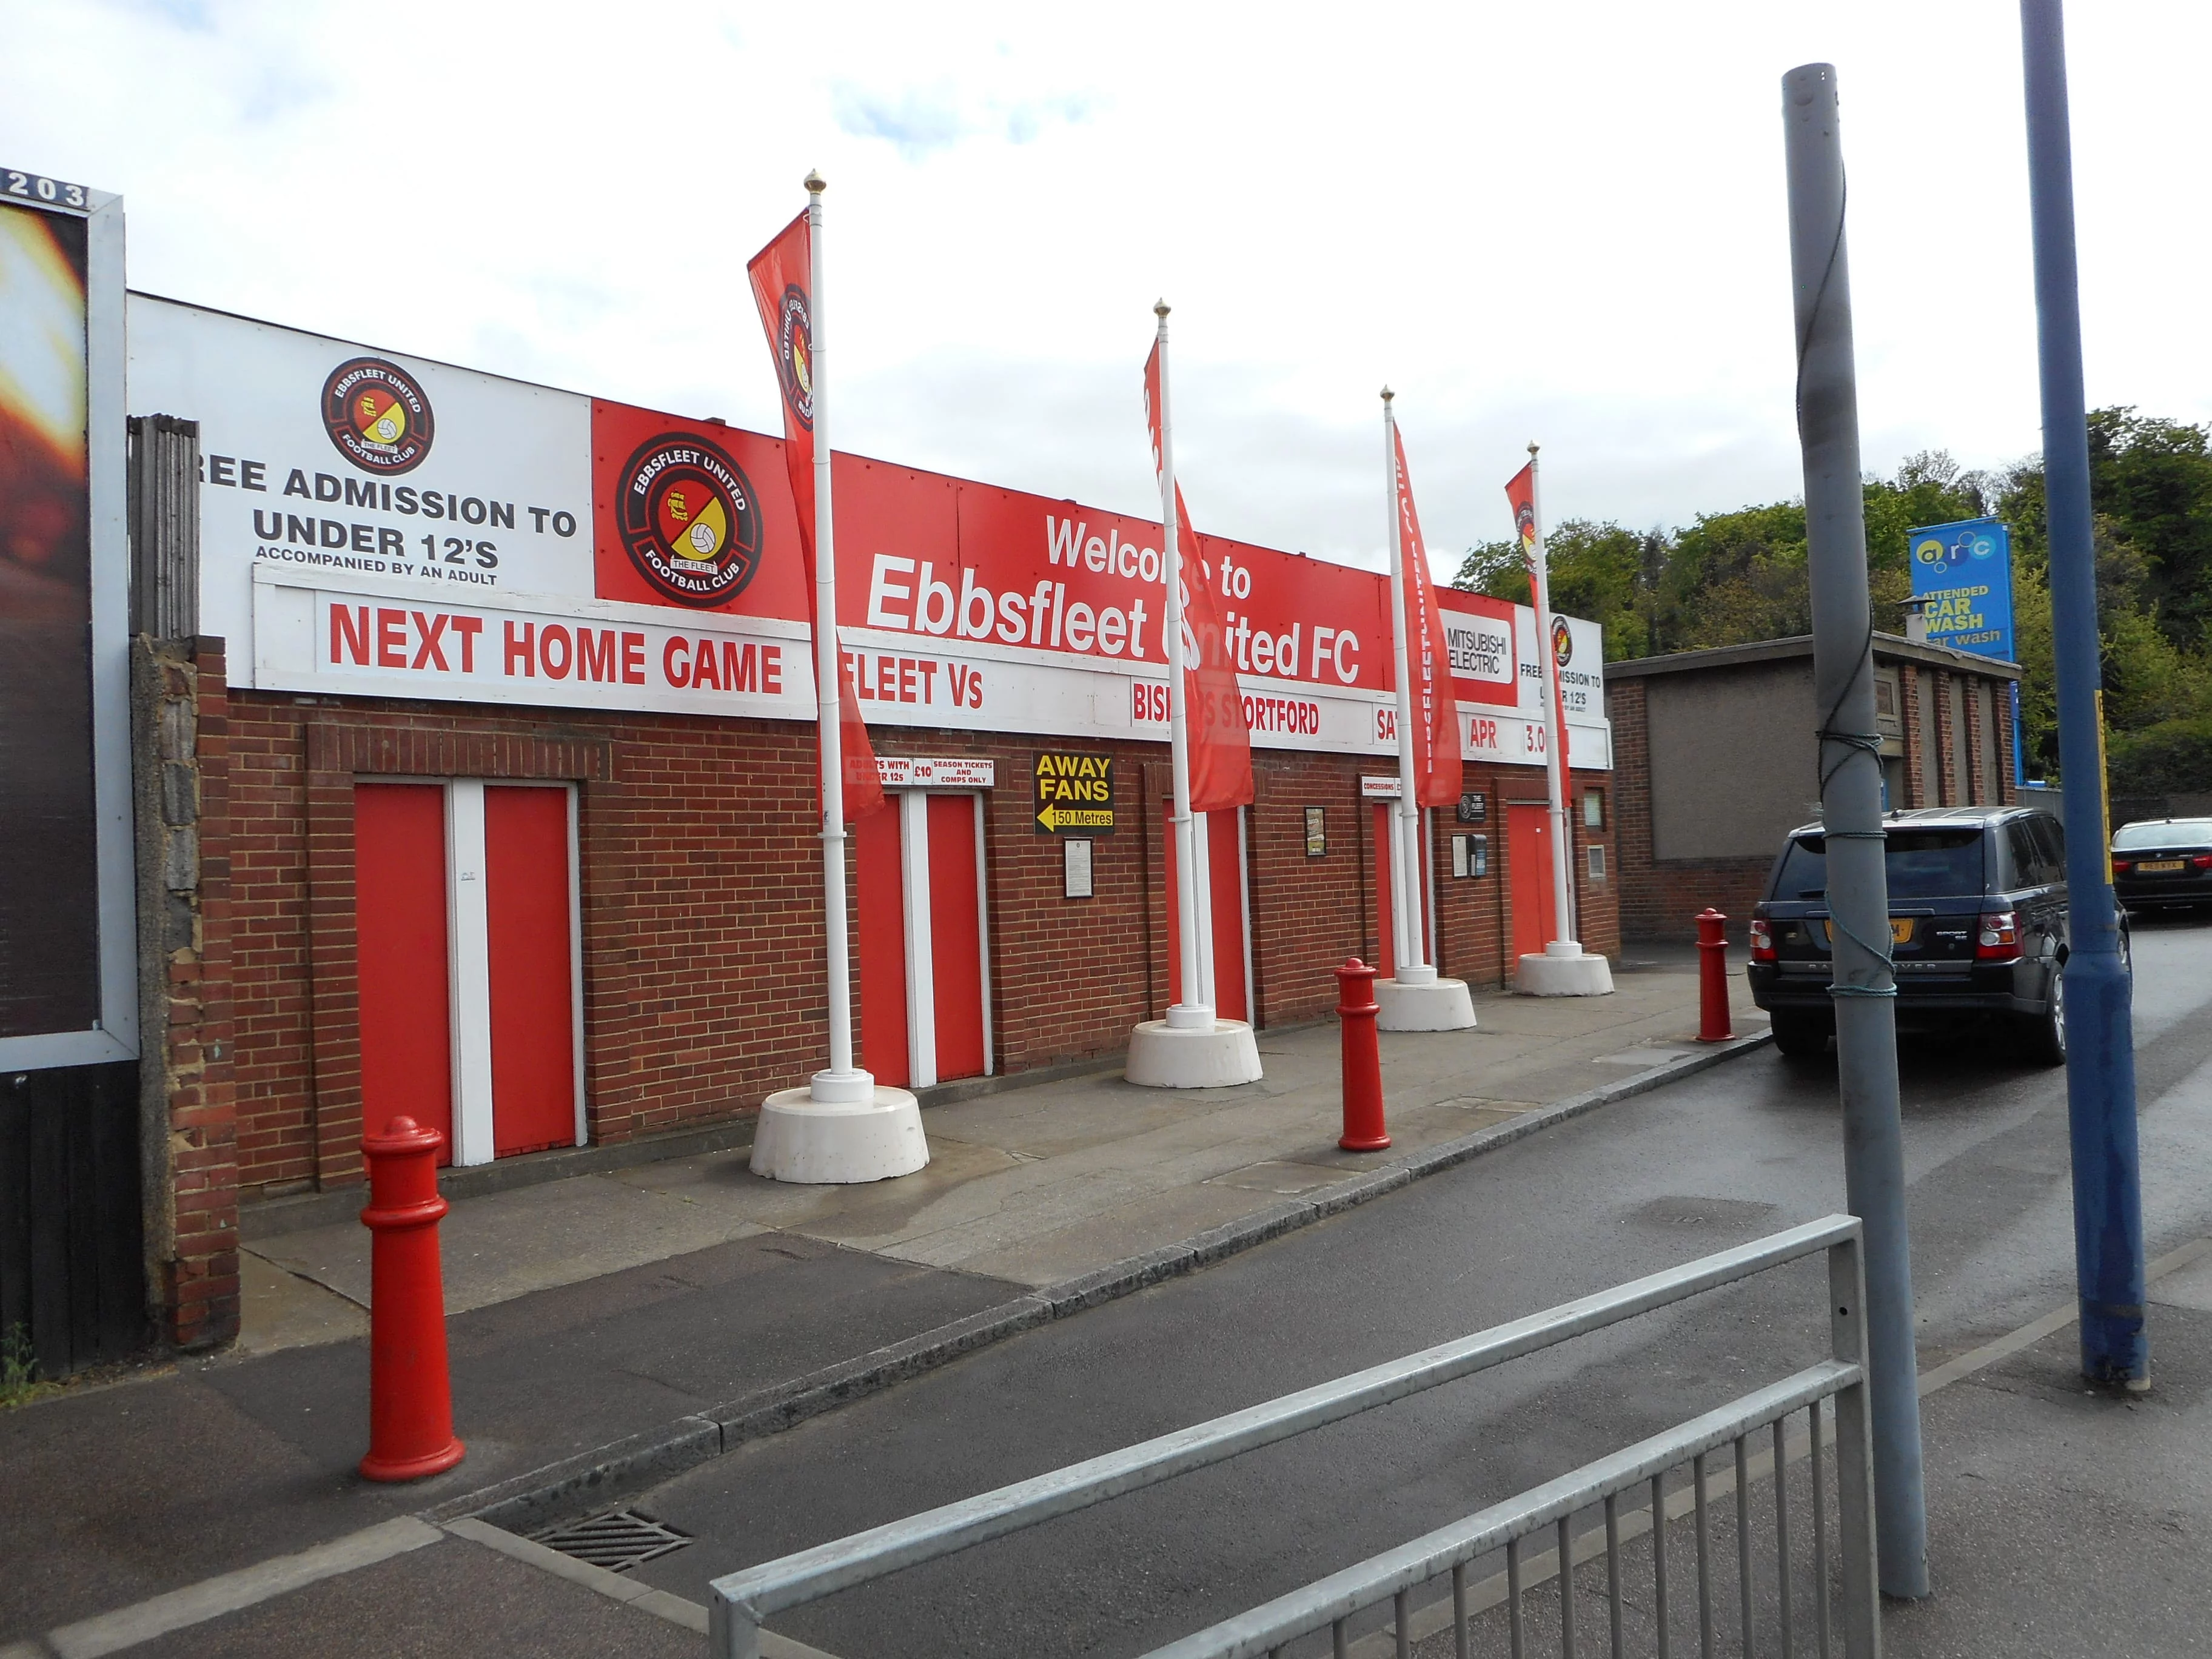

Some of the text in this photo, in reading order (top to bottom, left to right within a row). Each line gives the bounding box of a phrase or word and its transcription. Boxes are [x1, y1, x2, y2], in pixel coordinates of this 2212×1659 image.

[8, 172, 84, 206] 203
[335, 369, 421, 413] EBBSFLEET UNITED
[342, 434, 415, 464] FOOTBALL CLUB
[634, 449, 746, 511] EBBSFLEET UNITED
[199, 454, 577, 537] EE ADMISSION TO
[253, 509, 405, 557] UNDER
[255, 546, 497, 585] ACCOMPANIED BY AN ADULT
[645, 549, 740, 591] FOOTBALL CLUB
[674, 560, 715, 572] THE FLEET
[1221, 555, 1251, 599] to
[1923, 585, 1989, 600] ATTENDED
[867, 553, 1147, 658] Ebbsfleet
[1312, 626, 1359, 684] FC
[1925, 598, 1971, 618] CAR
[1925, 613, 1983, 633] WASH
[1447, 628, 1506, 655] MITSUBISHI
[1956, 629, 2000, 645] wash
[1449, 649, 1500, 674] ELECTRIC
[330, 603, 483, 673] NEXT
[504, 620, 645, 686] HOME
[663, 635, 782, 694] GAME
[1377, 709, 1398, 740] SA
[1470, 719, 1497, 749] APR
[1591, 675, 1600, 688] TO
[888, 760, 910, 769] WITH
[914, 766, 931, 777] £10
[1036, 755, 1111, 778] AWAY
[1040, 779, 1109, 802] FANS
[1364, 782, 1394, 791] CONCESSIONS
[1052, 811, 1111, 825] 150 Metres
